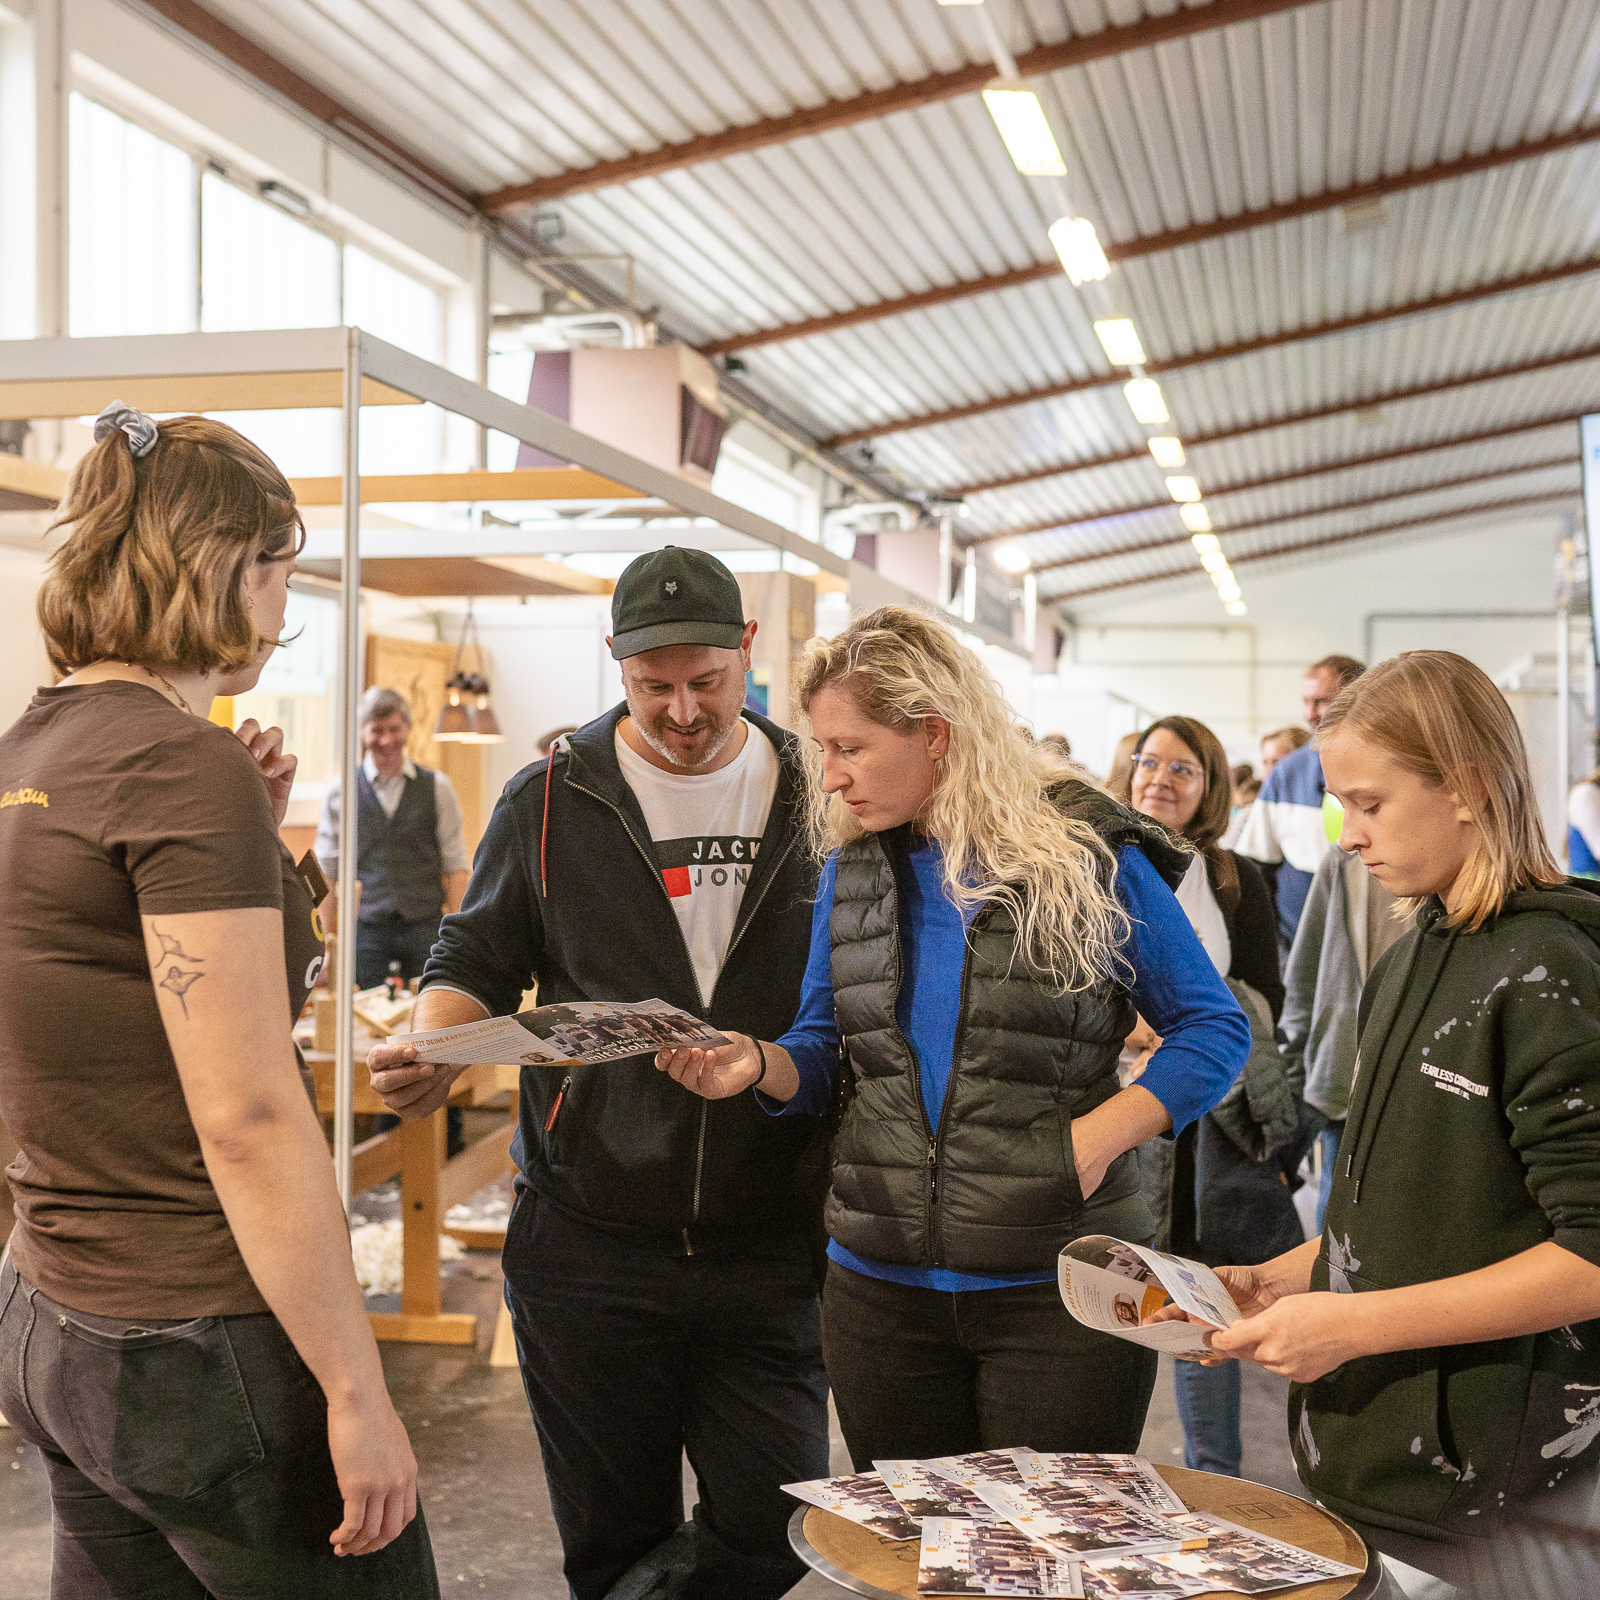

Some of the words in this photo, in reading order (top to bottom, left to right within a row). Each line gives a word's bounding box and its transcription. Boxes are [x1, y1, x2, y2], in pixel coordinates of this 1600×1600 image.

[426, 1037, 444, 1047] DEINE
[444, 1029, 477, 1042] KARRIERE
[613, 1041, 653, 1055] Holz
[1420, 1062, 1455, 1083] FEARLESS
[1064, 1263, 1072, 1295] FÜRST!
[1048, 1563, 1070, 1582] Holz
